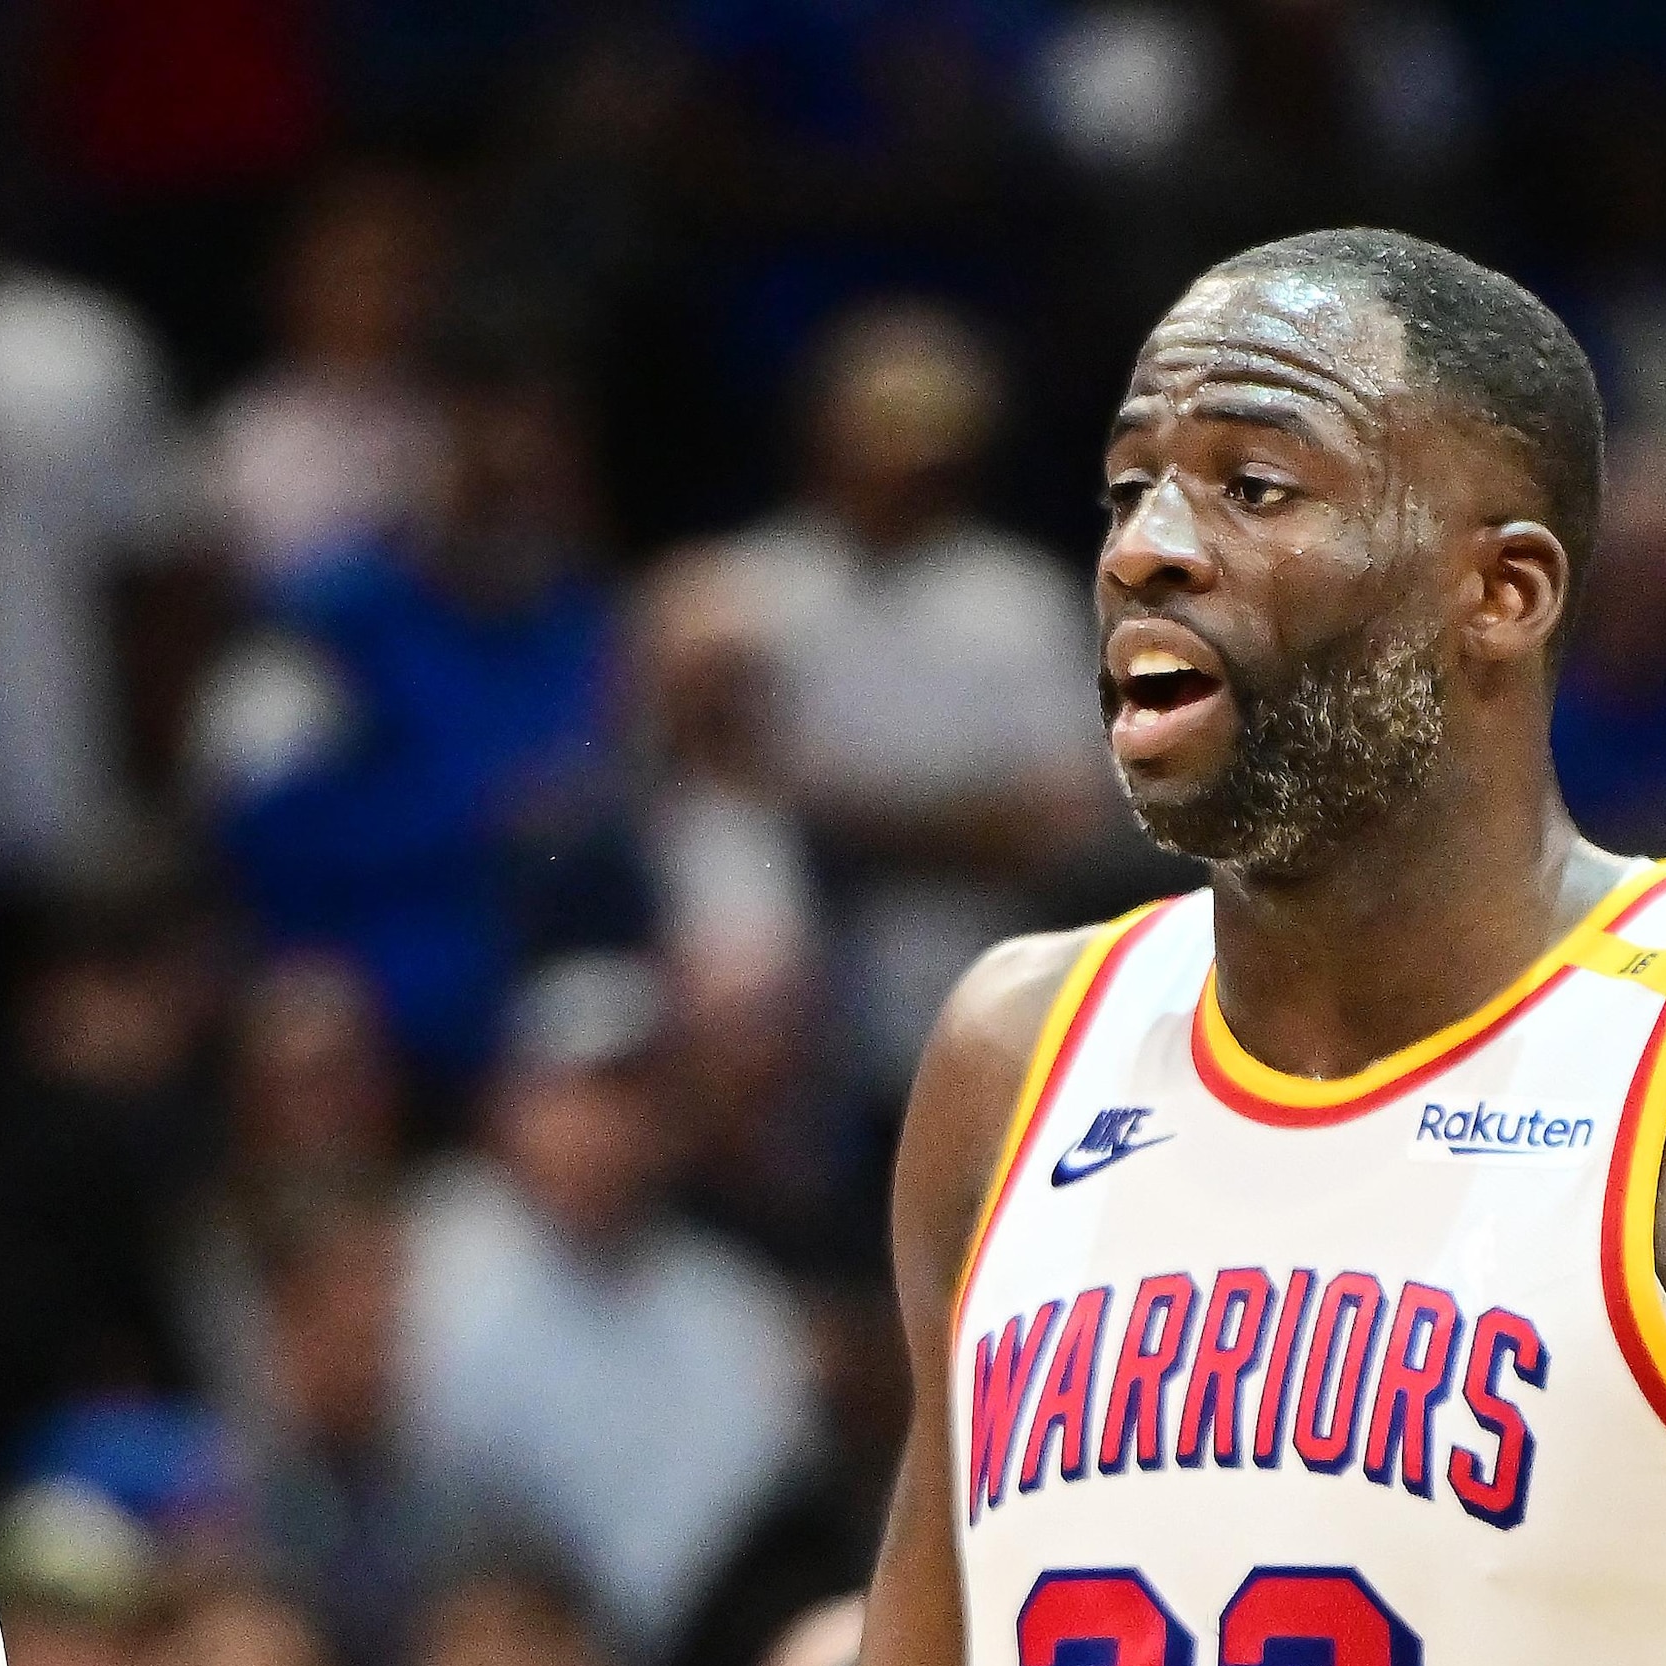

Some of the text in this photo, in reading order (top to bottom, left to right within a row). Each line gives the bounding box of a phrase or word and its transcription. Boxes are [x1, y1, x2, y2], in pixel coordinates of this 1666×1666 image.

[1075, 1106, 1154, 1153] NIKE
[1416, 1100, 1595, 1148] Rakuten
[969, 1266, 1550, 1531] WARRIORS
